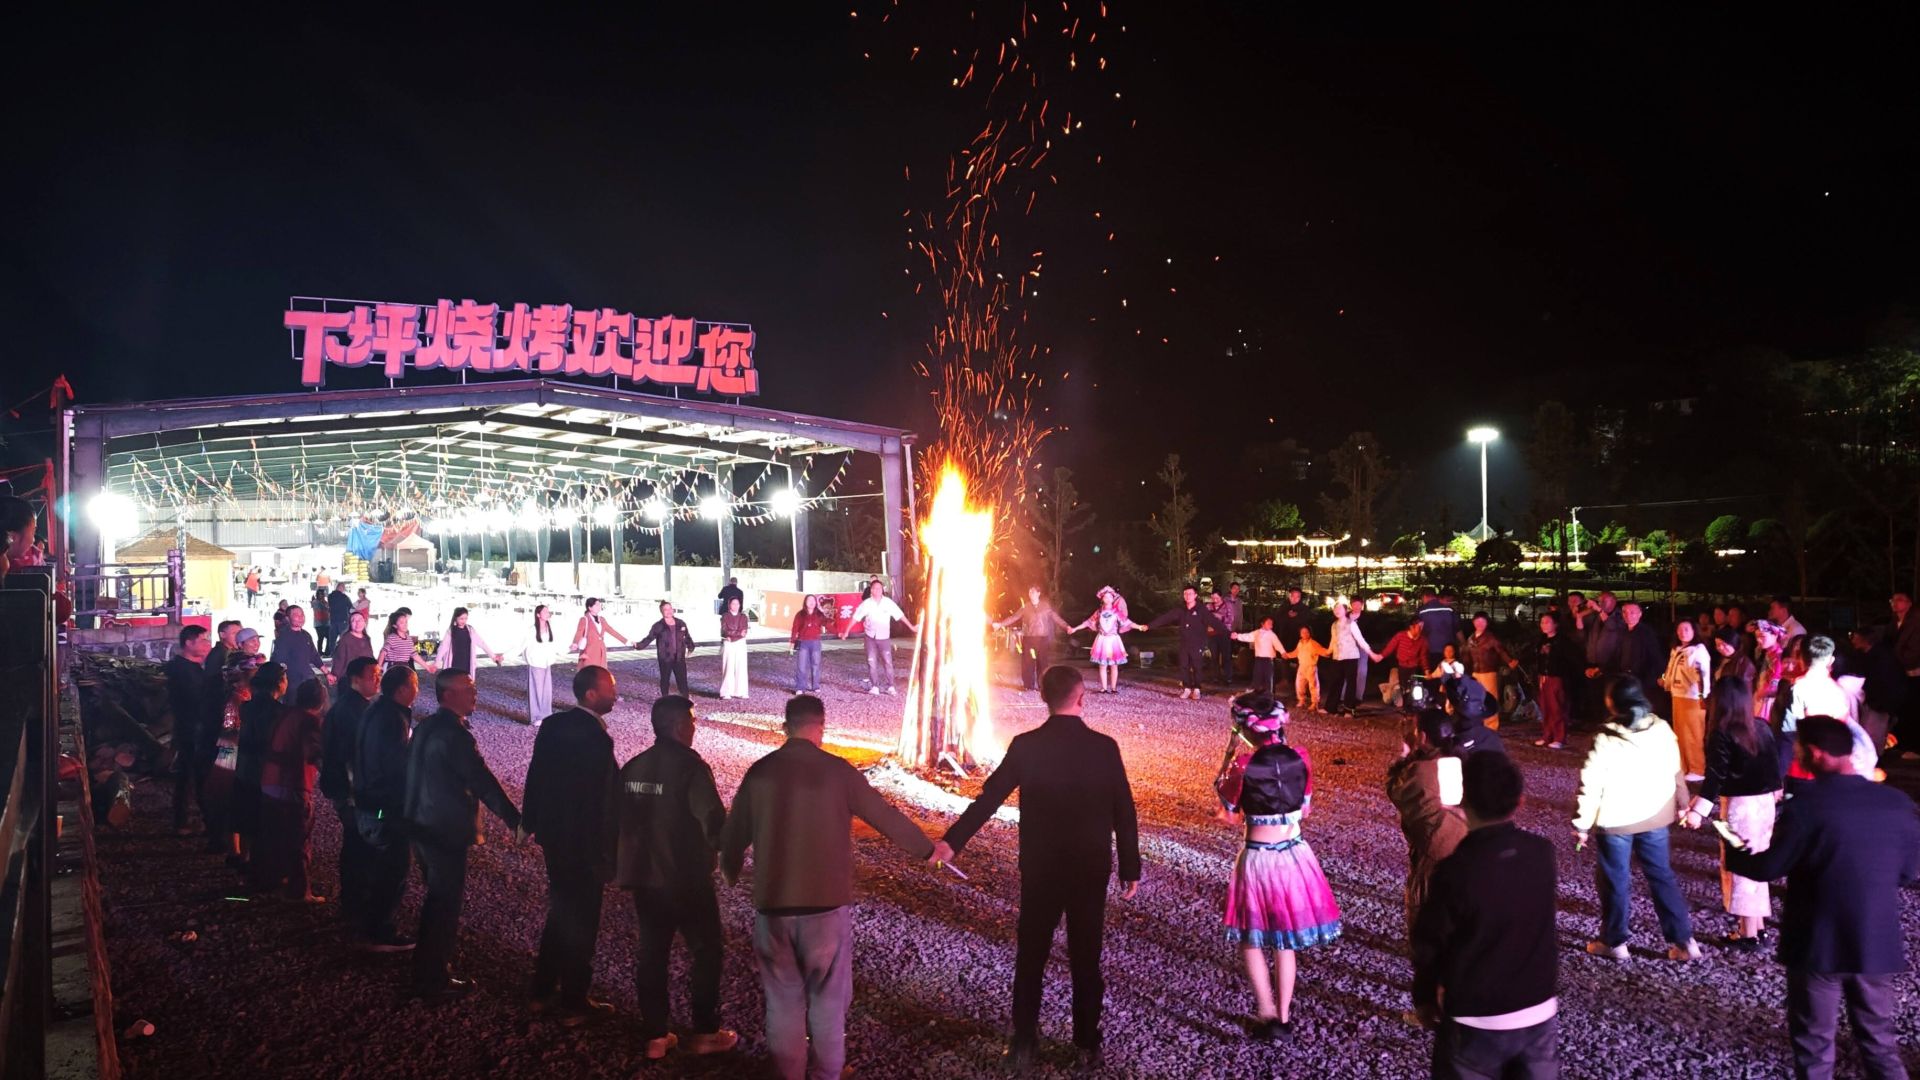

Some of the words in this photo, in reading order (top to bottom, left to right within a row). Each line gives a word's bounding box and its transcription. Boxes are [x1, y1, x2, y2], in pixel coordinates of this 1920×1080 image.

[284, 298, 759, 396] 下坪烧烤欢迎您
